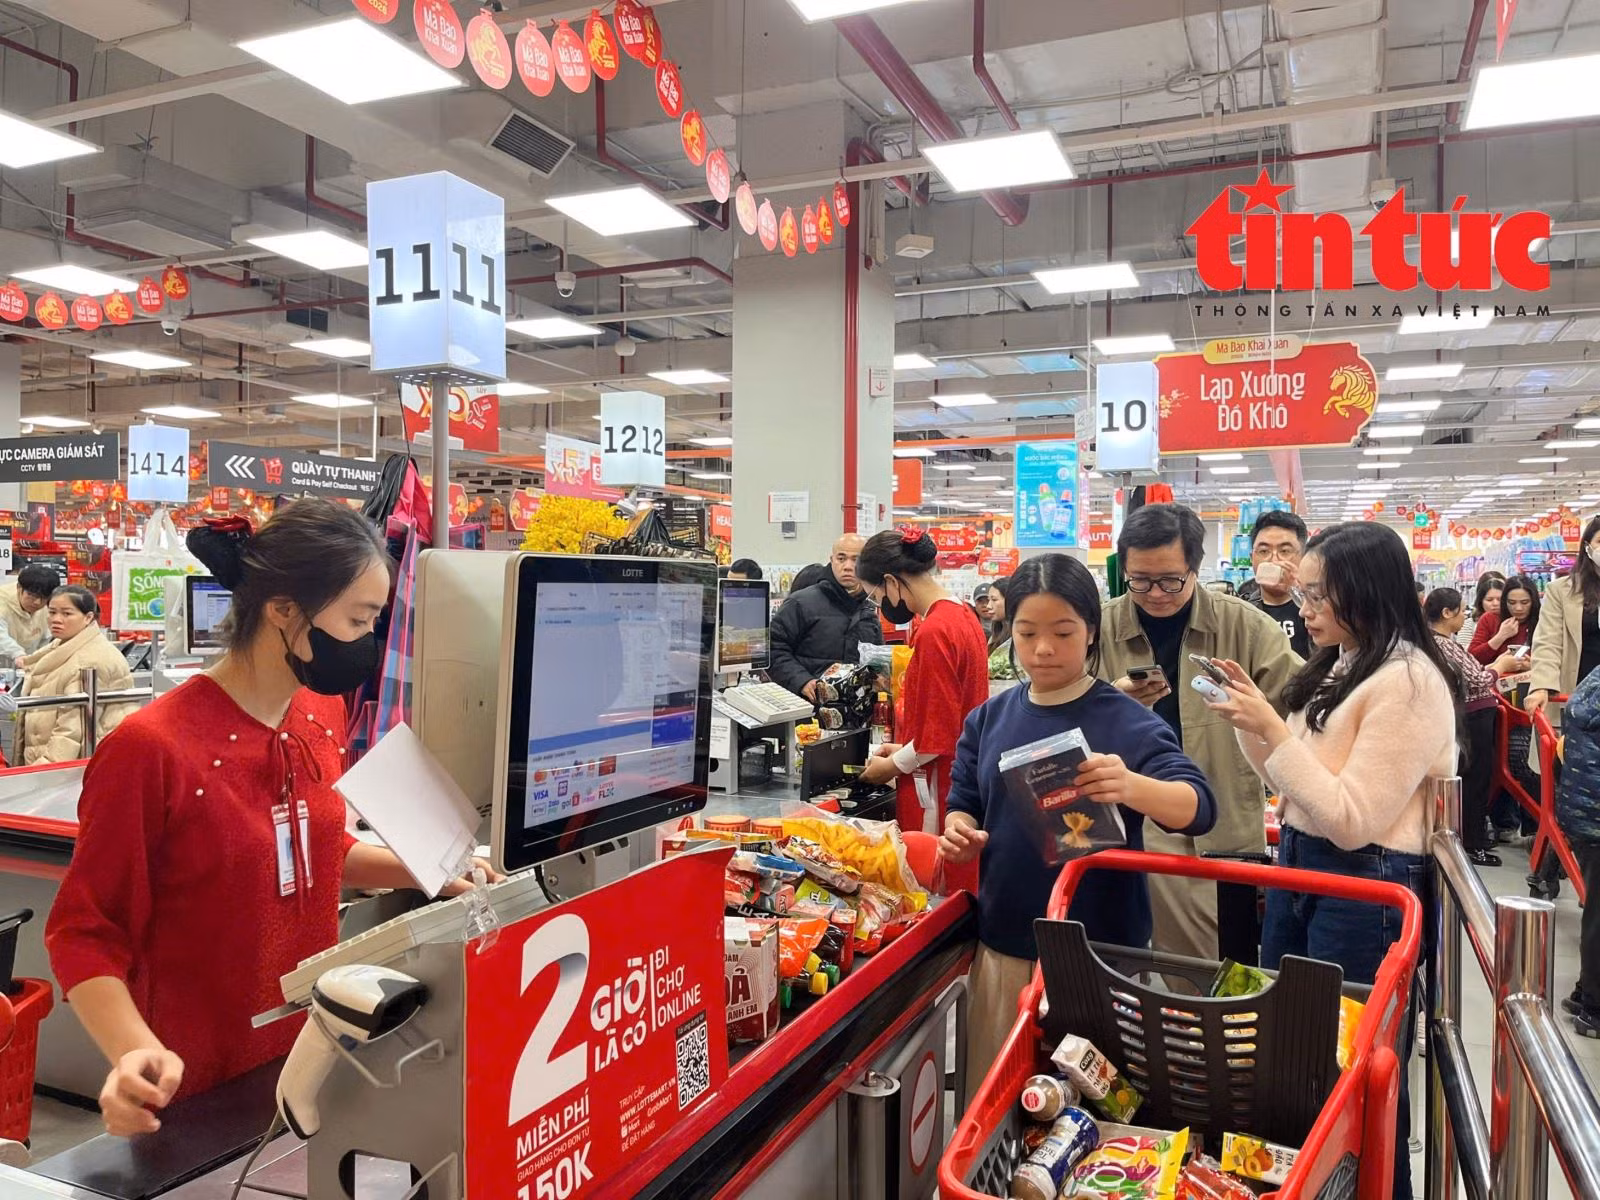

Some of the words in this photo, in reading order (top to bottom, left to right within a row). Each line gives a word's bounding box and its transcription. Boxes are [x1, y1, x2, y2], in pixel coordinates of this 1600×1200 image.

[374, 242, 440, 306] 11
[452, 242, 501, 316] 11
[1200, 373, 1233, 405] Lạp
[1100, 400, 1148, 433] 10
[1249, 400, 1288, 430] Khô
[14, 447, 55, 460] CAMERA
[56, 442, 83, 459] GIÁM
[84, 441, 105, 458] SÁT
[604, 424, 637, 454] 12
[641, 425, 664, 457] 12
[20, 464, 36, 472] CCTV
[130, 452, 152, 475] 14
[156, 452, 186, 477] 14
[291, 460, 323, 476] QUẦY
[340, 467, 376, 482] THANH
[291, 477, 306, 486] Card
[306, 478, 311, 486] &
[311, 479, 322, 488] Pay
[132, 570, 164, 593] SỐN
[622, 568, 644, 577] LOTTE
[533, 789, 549, 801] VISA
[1042, 788, 1079, 808] Barilla
[655, 945, 669, 971] ĐI
[656, 964, 685, 998] CHỢ
[657, 983, 701, 1028] ONLINE
[727, 1007, 744, 1021] ANH
[746, 1003, 758, 1015] EM
[507, 913, 590, 1127] 2
[595, 1027, 619, 1073] LÀ
[621, 1006, 647, 1054] CÓ
[1080, 1050, 1094, 1070] Cozy
[516, 1112, 561, 1160] MIỄN
[563, 1087, 589, 1130] PHÍ
[517, 1165, 534, 1183] GIAO
[534, 1151, 553, 1171] HÀNG
[553, 1142, 567, 1158] CHO
[567, 1133, 581, 1150] ĐƠN
